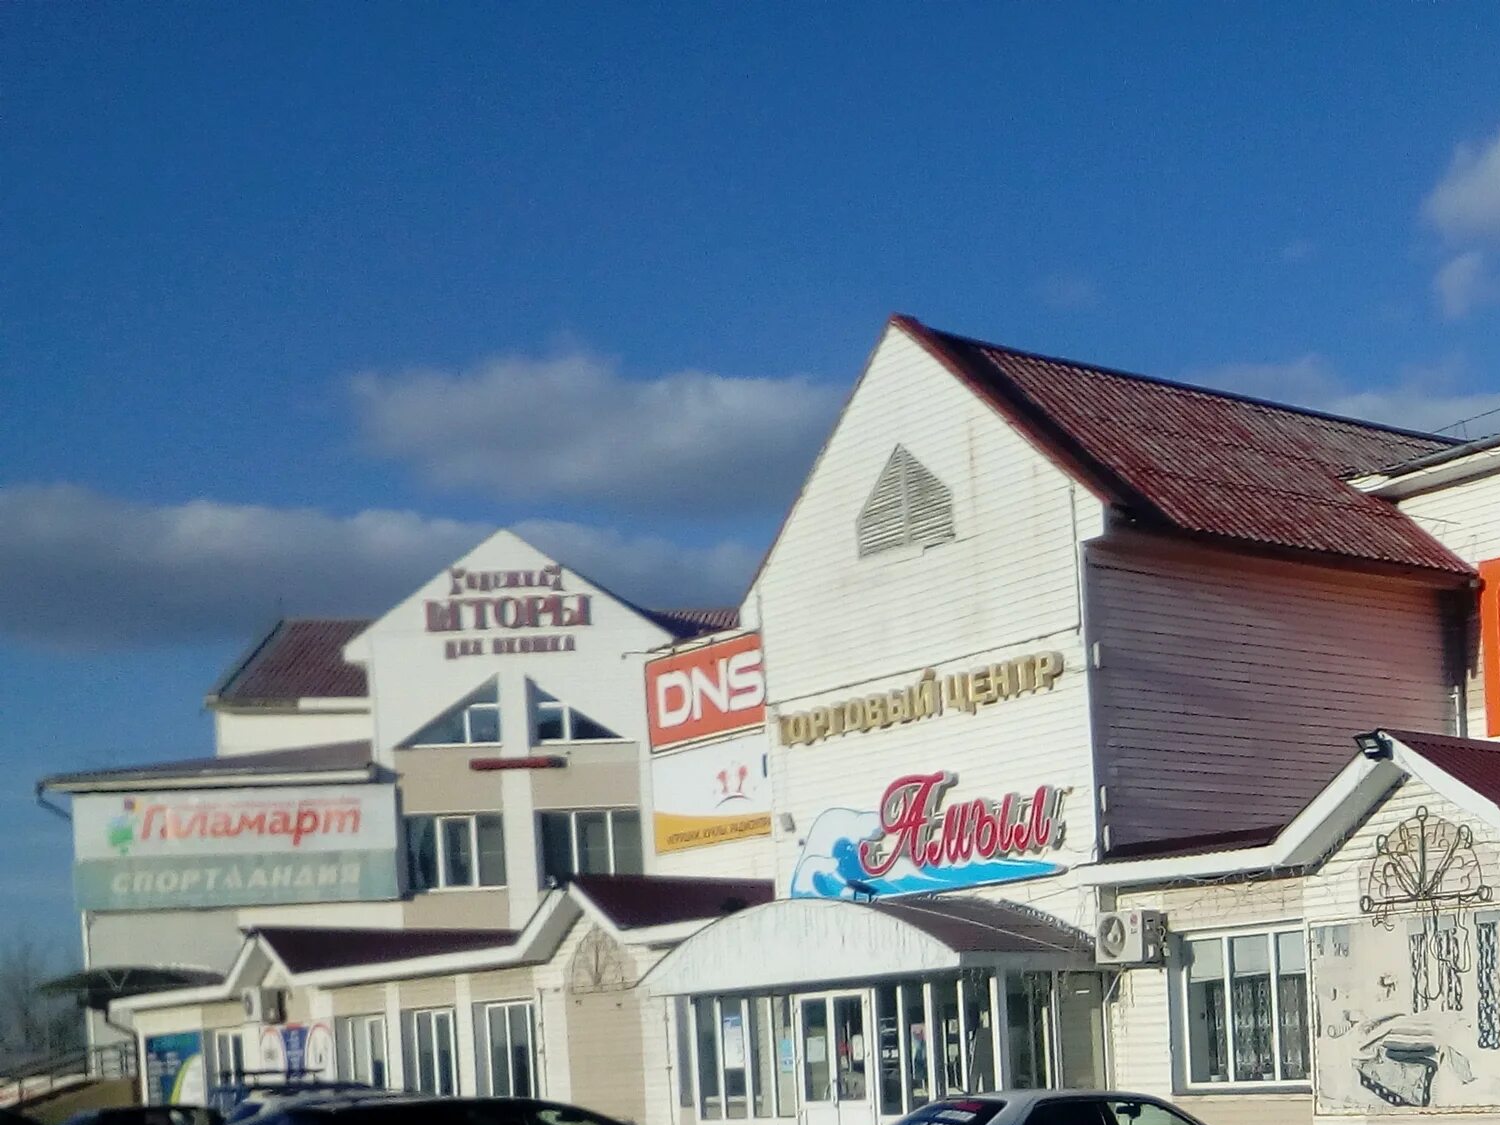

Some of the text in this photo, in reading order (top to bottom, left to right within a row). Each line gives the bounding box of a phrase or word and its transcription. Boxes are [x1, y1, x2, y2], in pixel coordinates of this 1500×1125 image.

[656, 649, 765, 729] DNS
[779, 651, 1064, 748] ТОРГОВЫЙ ЦЕНТР
[860, 770, 1060, 876] Амыл
[111, 862, 361, 894] СПОРТЛАНДИЯ
